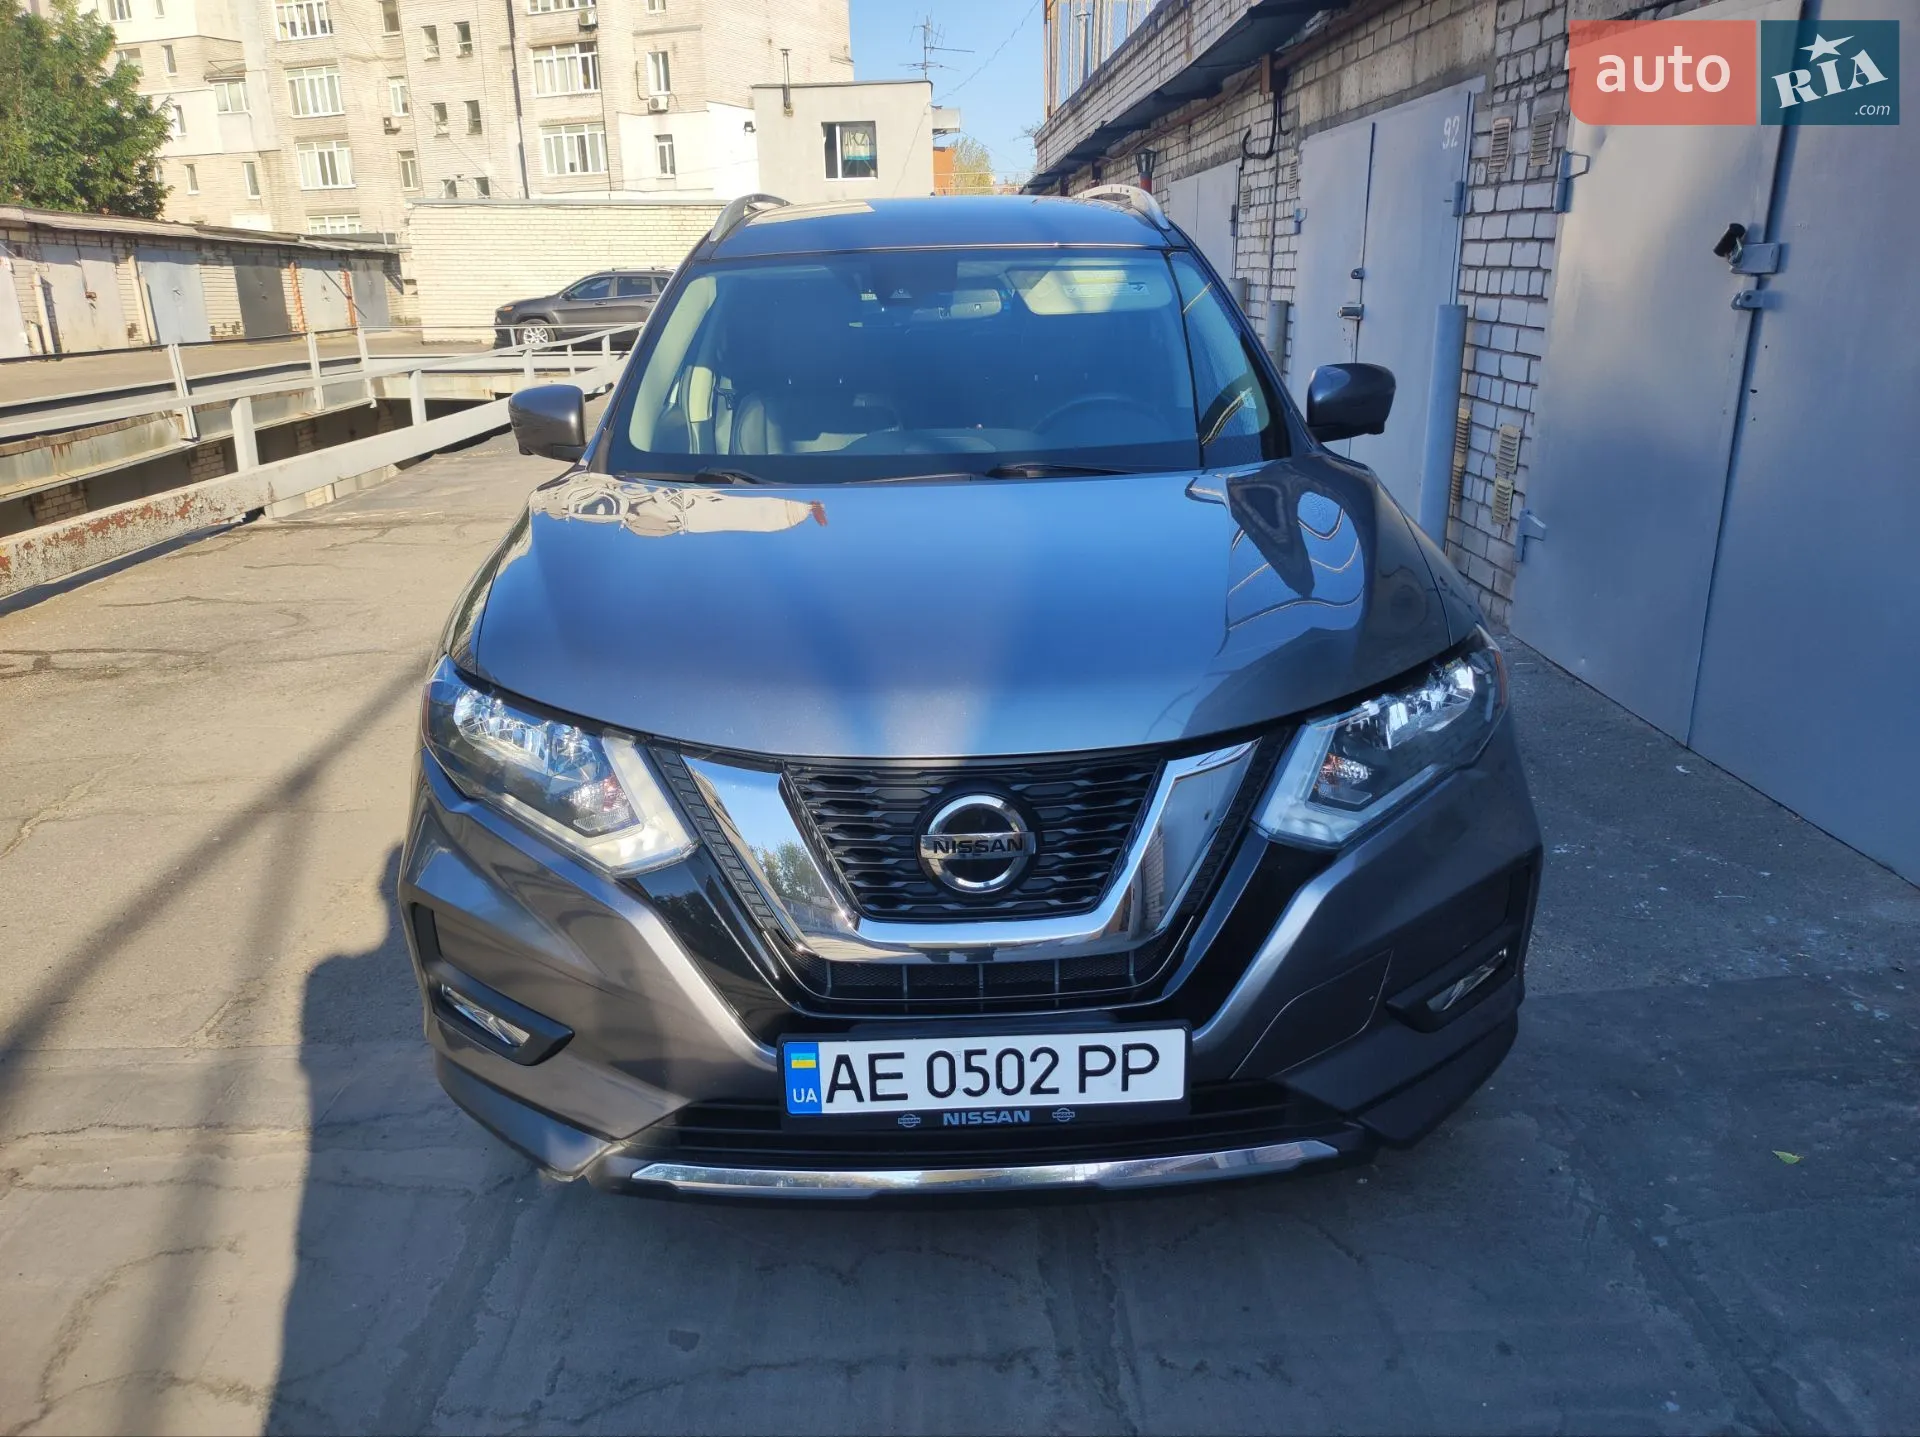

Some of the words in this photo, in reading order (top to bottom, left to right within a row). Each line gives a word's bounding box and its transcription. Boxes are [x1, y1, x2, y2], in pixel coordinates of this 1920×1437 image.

[1442, 116, 1460, 150] 92
[933, 838, 1024, 854] NISSAN
[825, 1051, 908, 1104] AE
[926, 1046, 1060, 1099] 0502
[1078, 1042, 1160, 1094] PP
[792, 1087, 818, 1103] UA
[943, 1110, 1030, 1126] NISSAN
